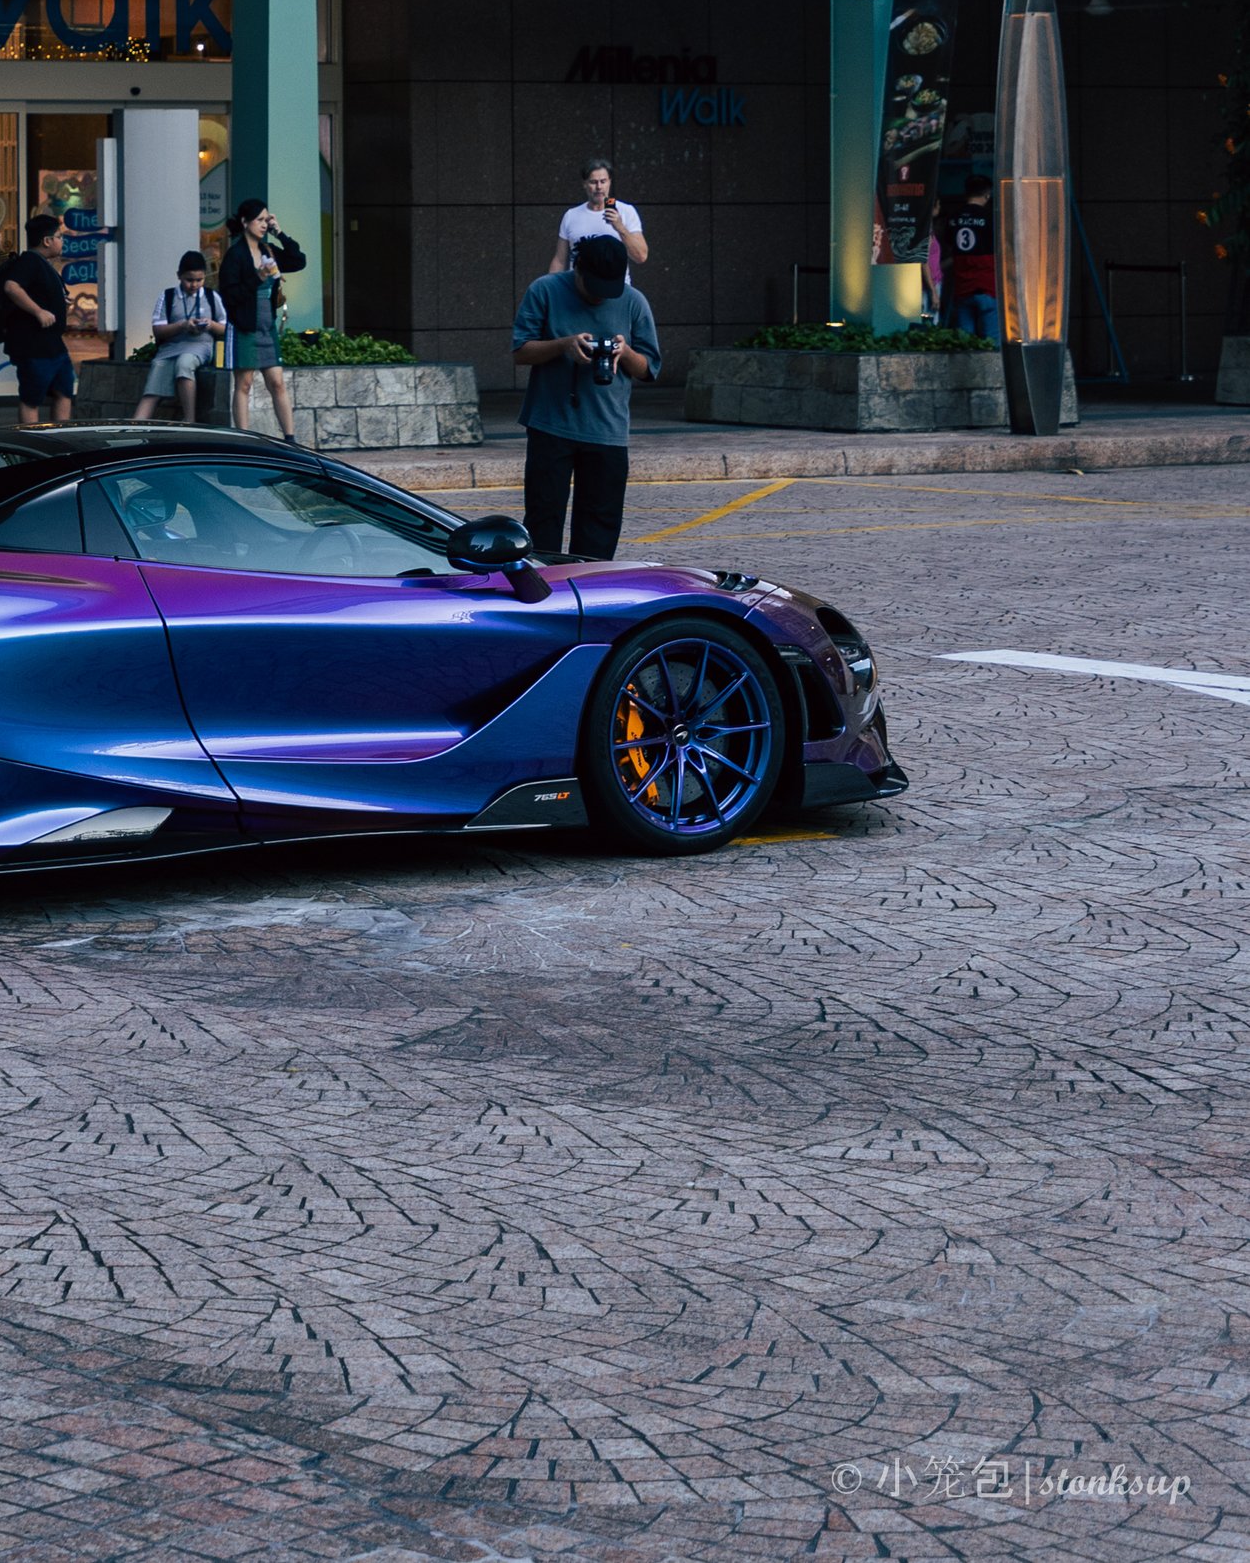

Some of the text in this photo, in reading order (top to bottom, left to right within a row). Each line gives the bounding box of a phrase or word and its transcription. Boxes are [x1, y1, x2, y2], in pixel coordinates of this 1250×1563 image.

[565, 45, 717, 83] Millenia
[659, 86, 747, 126] Walk
[72, 212, 98, 228] The
[961, 230, 970, 249] 3
[68, 262, 98, 282] Agl
[533, 791, 570, 802] 765LT
